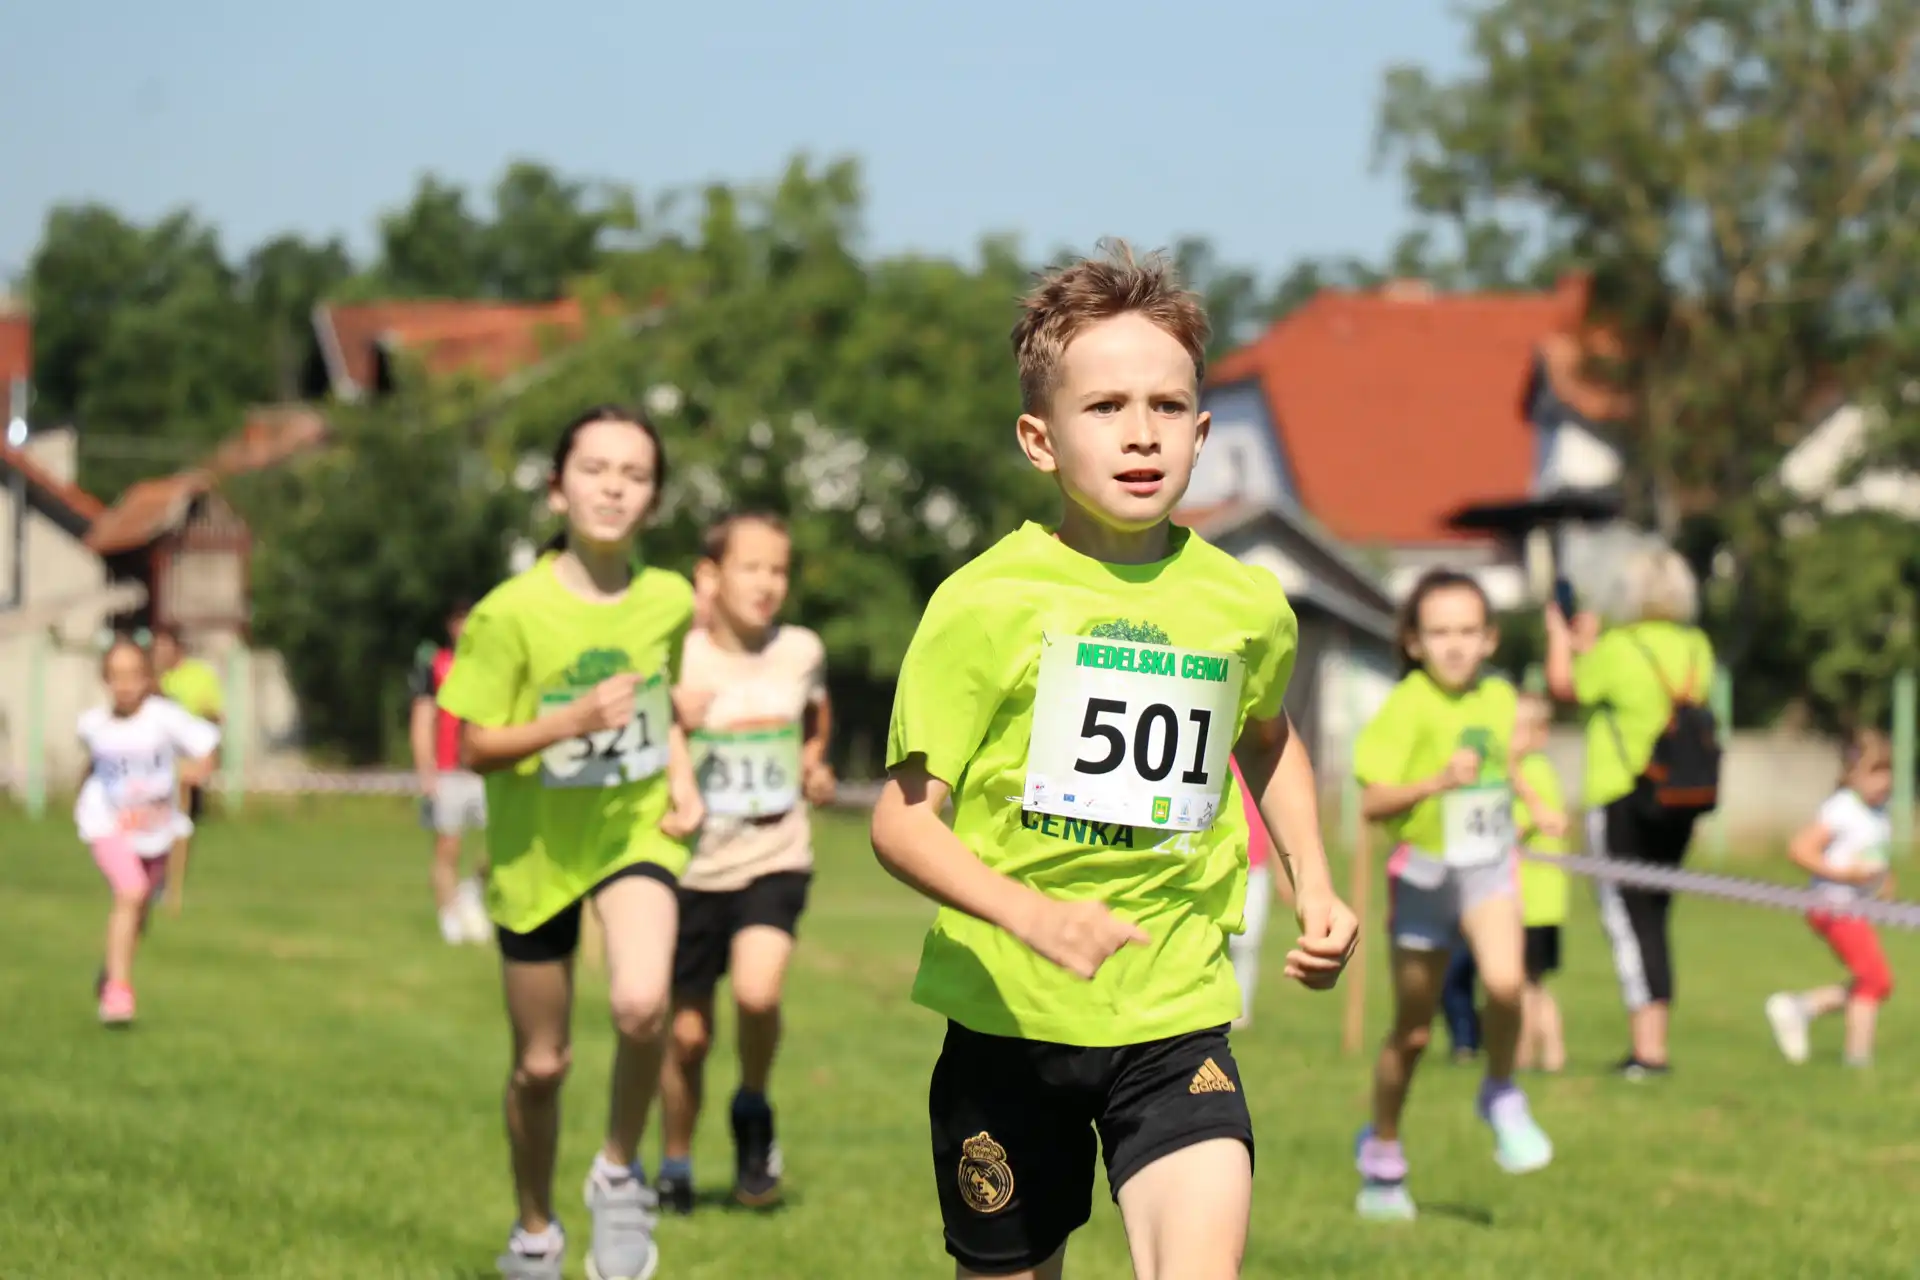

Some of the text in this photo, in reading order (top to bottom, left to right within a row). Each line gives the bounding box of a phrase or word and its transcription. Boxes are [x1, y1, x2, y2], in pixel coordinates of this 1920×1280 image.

[1076, 643, 1229, 682] NEDELSKA CENKA
[1073, 697, 1211, 785] 501
[1021, 809, 1134, 849] CENKA
